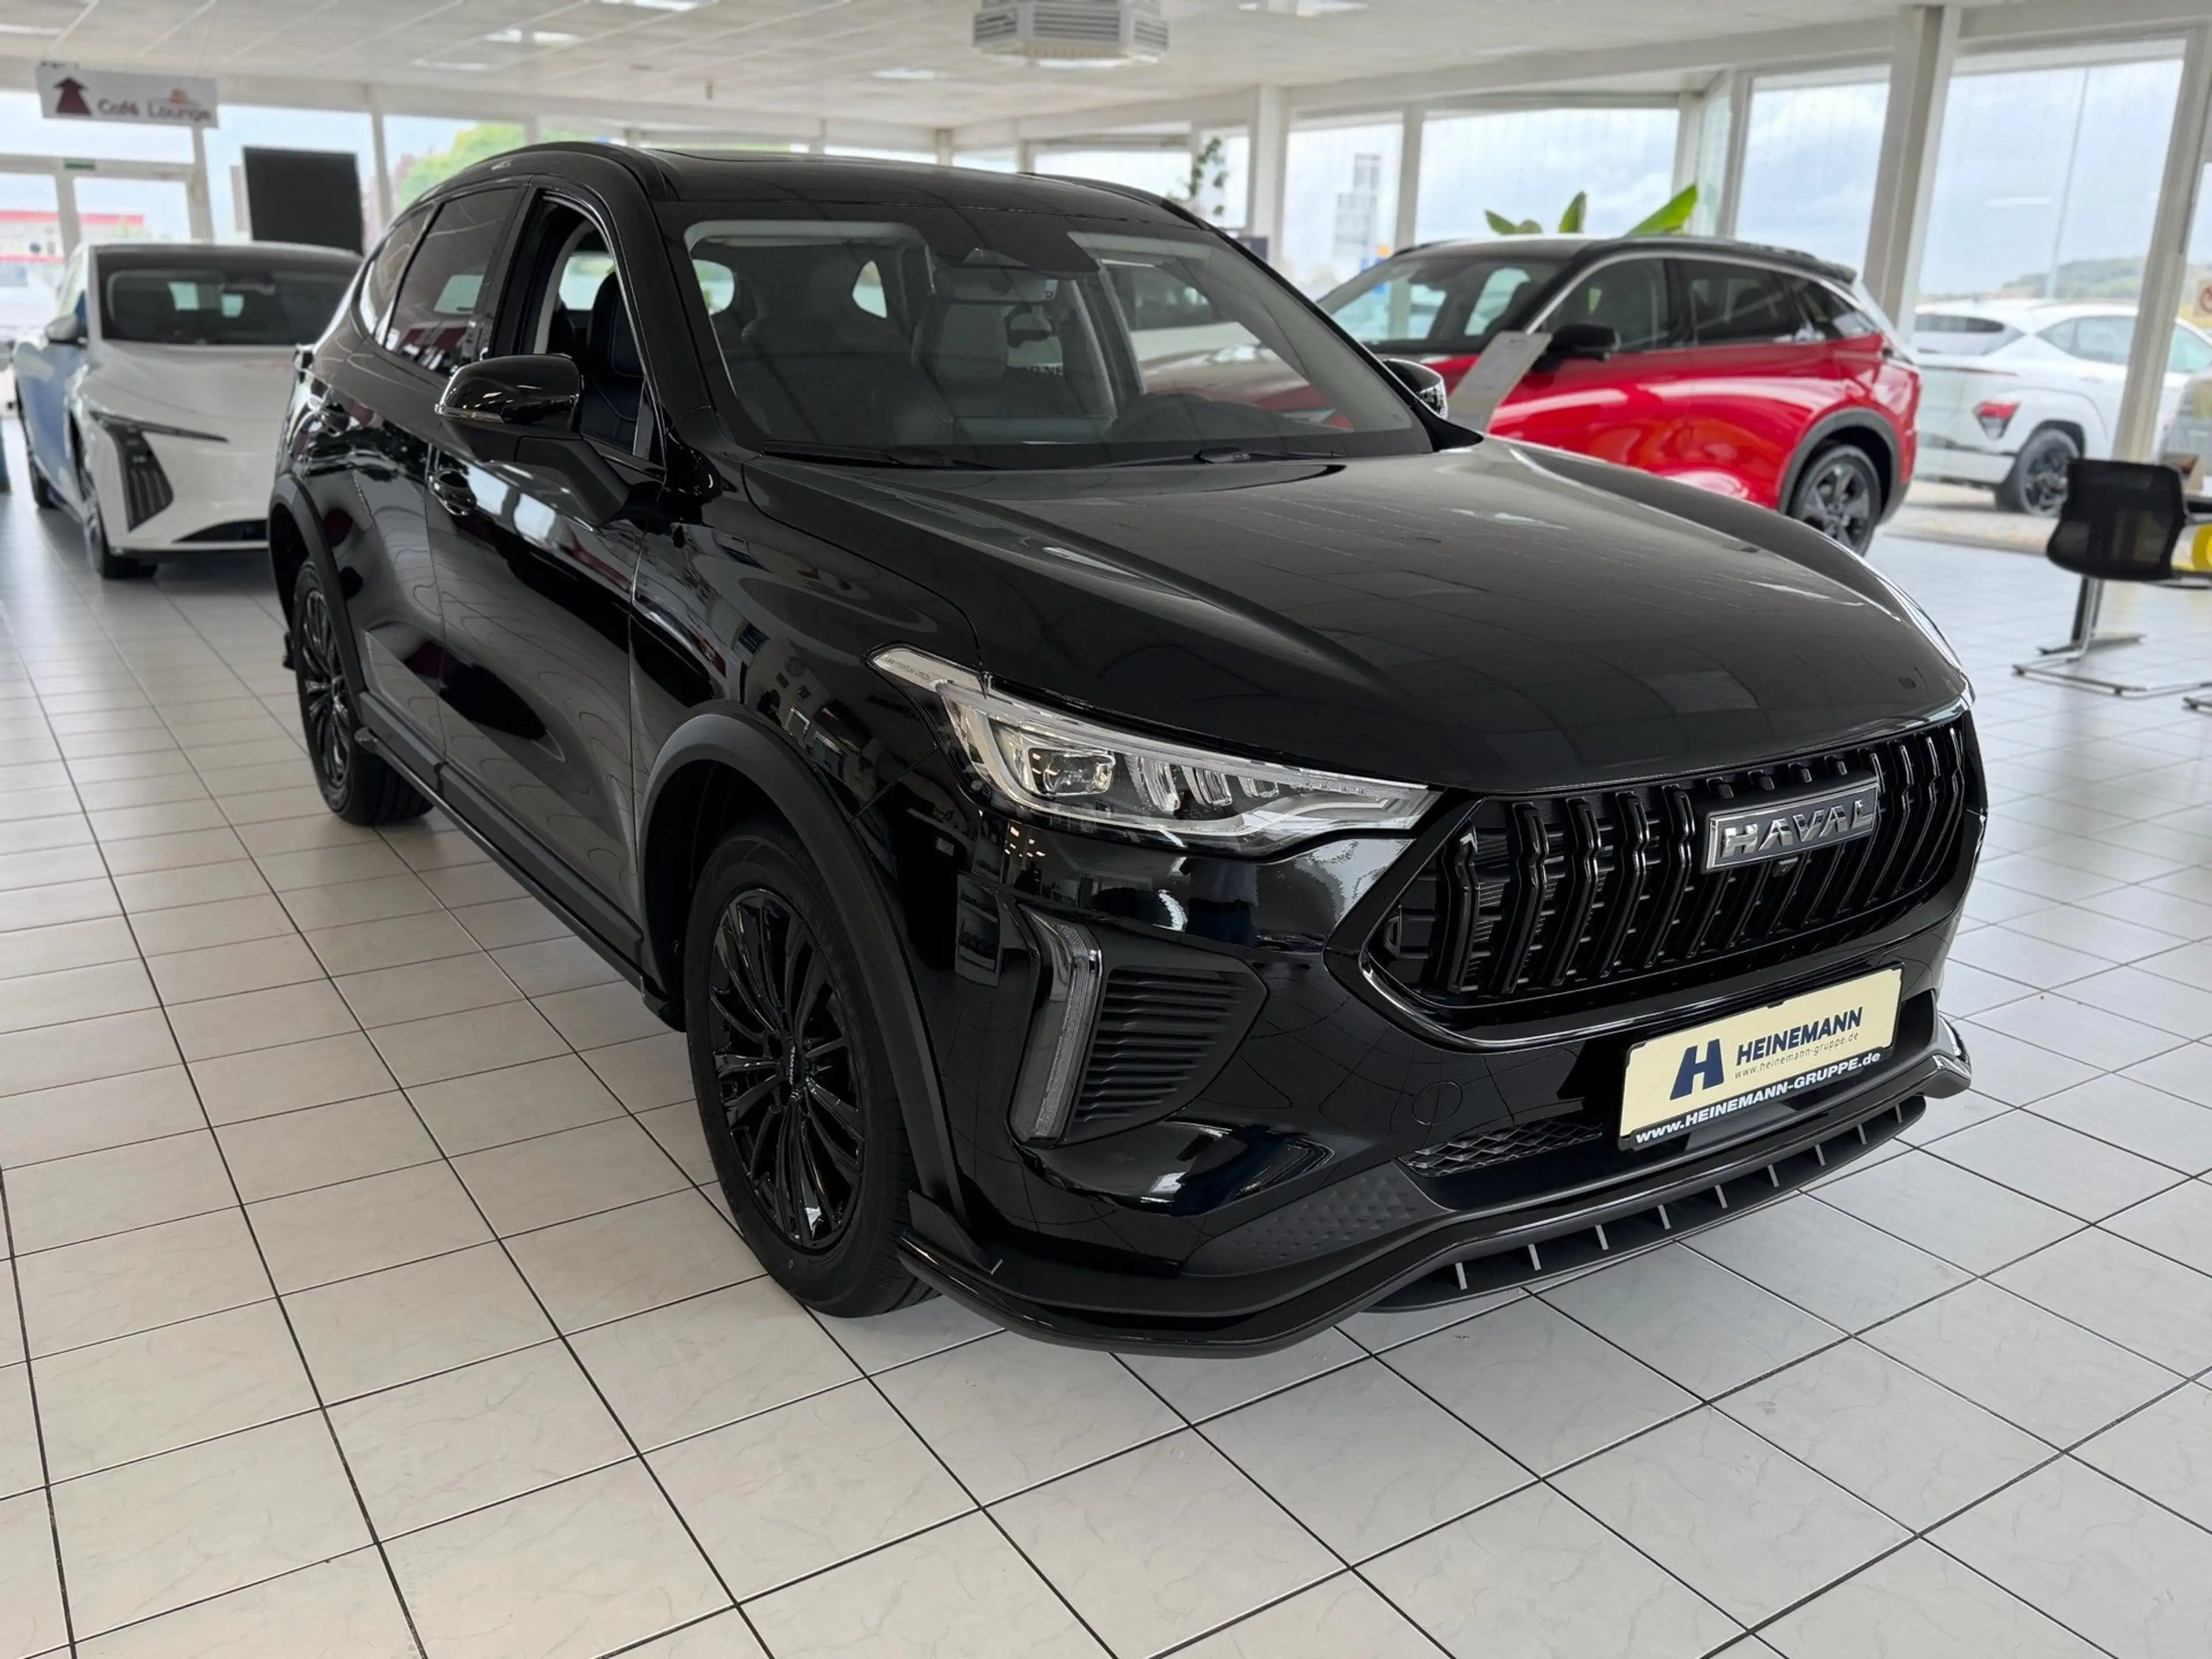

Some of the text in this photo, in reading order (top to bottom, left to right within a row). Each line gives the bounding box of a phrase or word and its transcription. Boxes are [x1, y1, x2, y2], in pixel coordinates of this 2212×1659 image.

[146, 100, 211, 123] Lounge
[1721, 799, 1875, 858] HAVAL
[1734, 1031, 1859, 1079] www.heinemann-gruppe.de
[1736, 1006, 1863, 1066] HEINEMANN
[1635, 1052, 1881, 1144] www.HEINEMANN-GRUPPE.de
